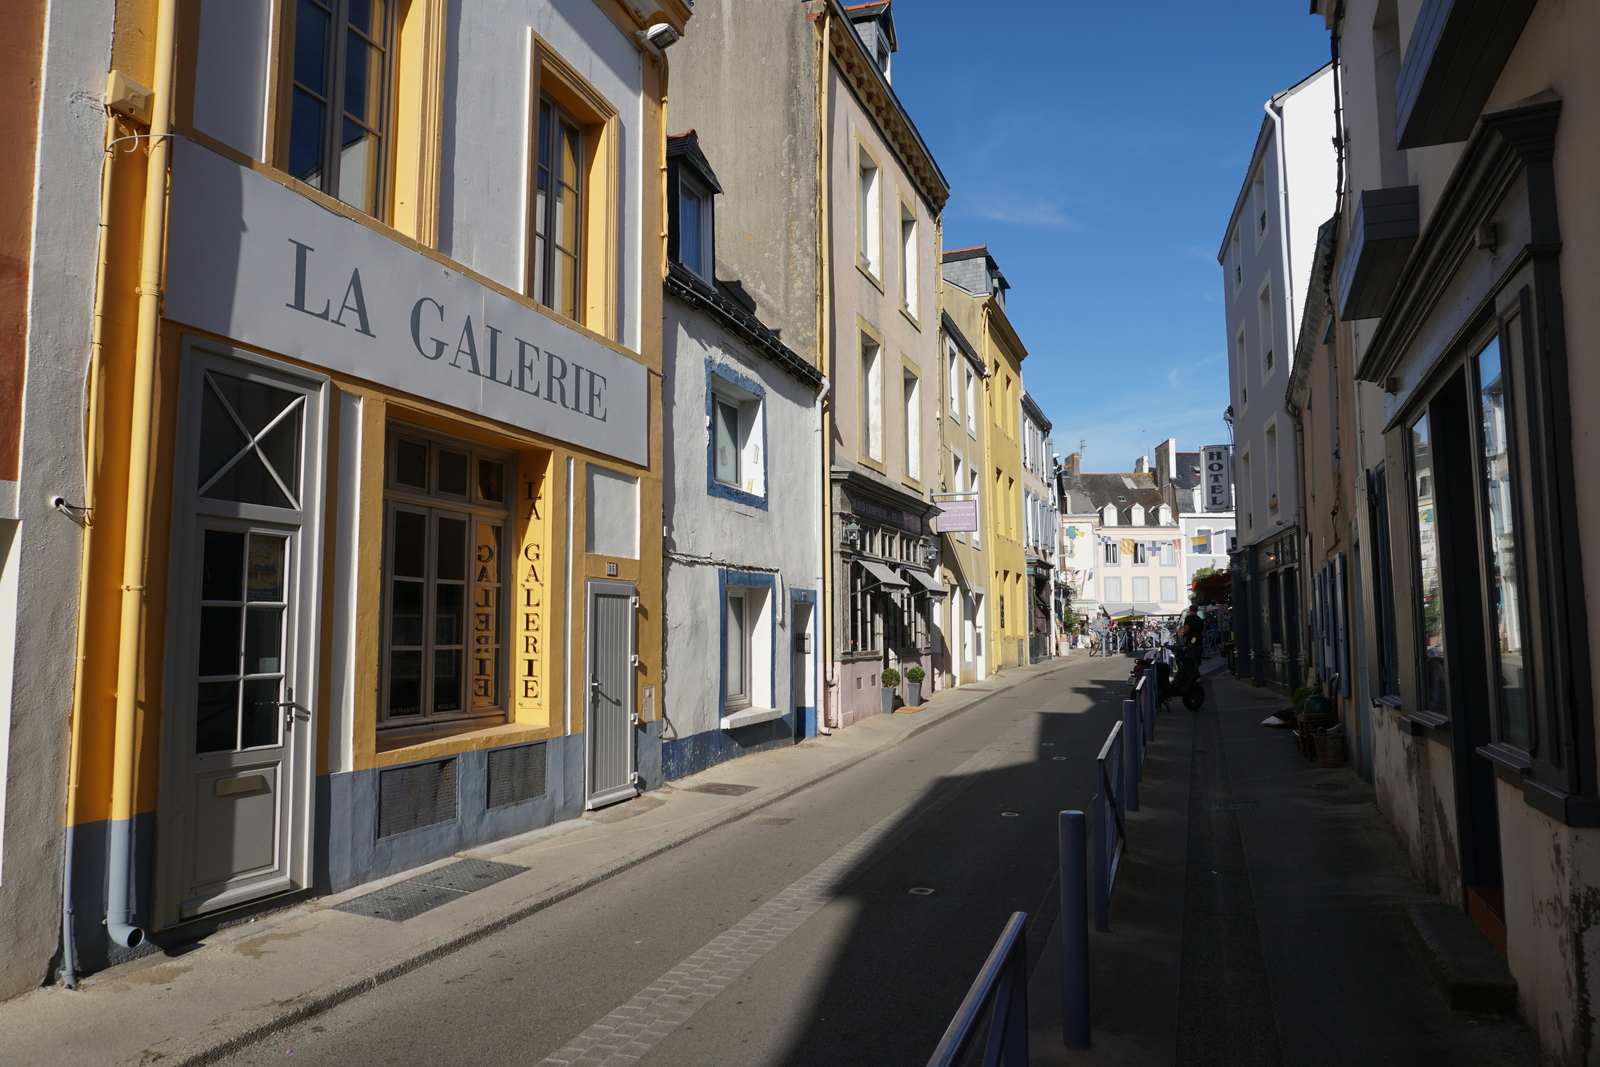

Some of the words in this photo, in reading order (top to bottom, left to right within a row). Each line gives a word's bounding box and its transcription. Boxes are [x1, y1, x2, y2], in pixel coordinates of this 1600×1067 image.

[286, 238, 376, 338] LA
[410, 297, 607, 422] GALERIE
[525, 482, 541, 520] LA
[1208, 451, 1224, 505] HOTEL
[522, 543, 541, 698] GALERIE
